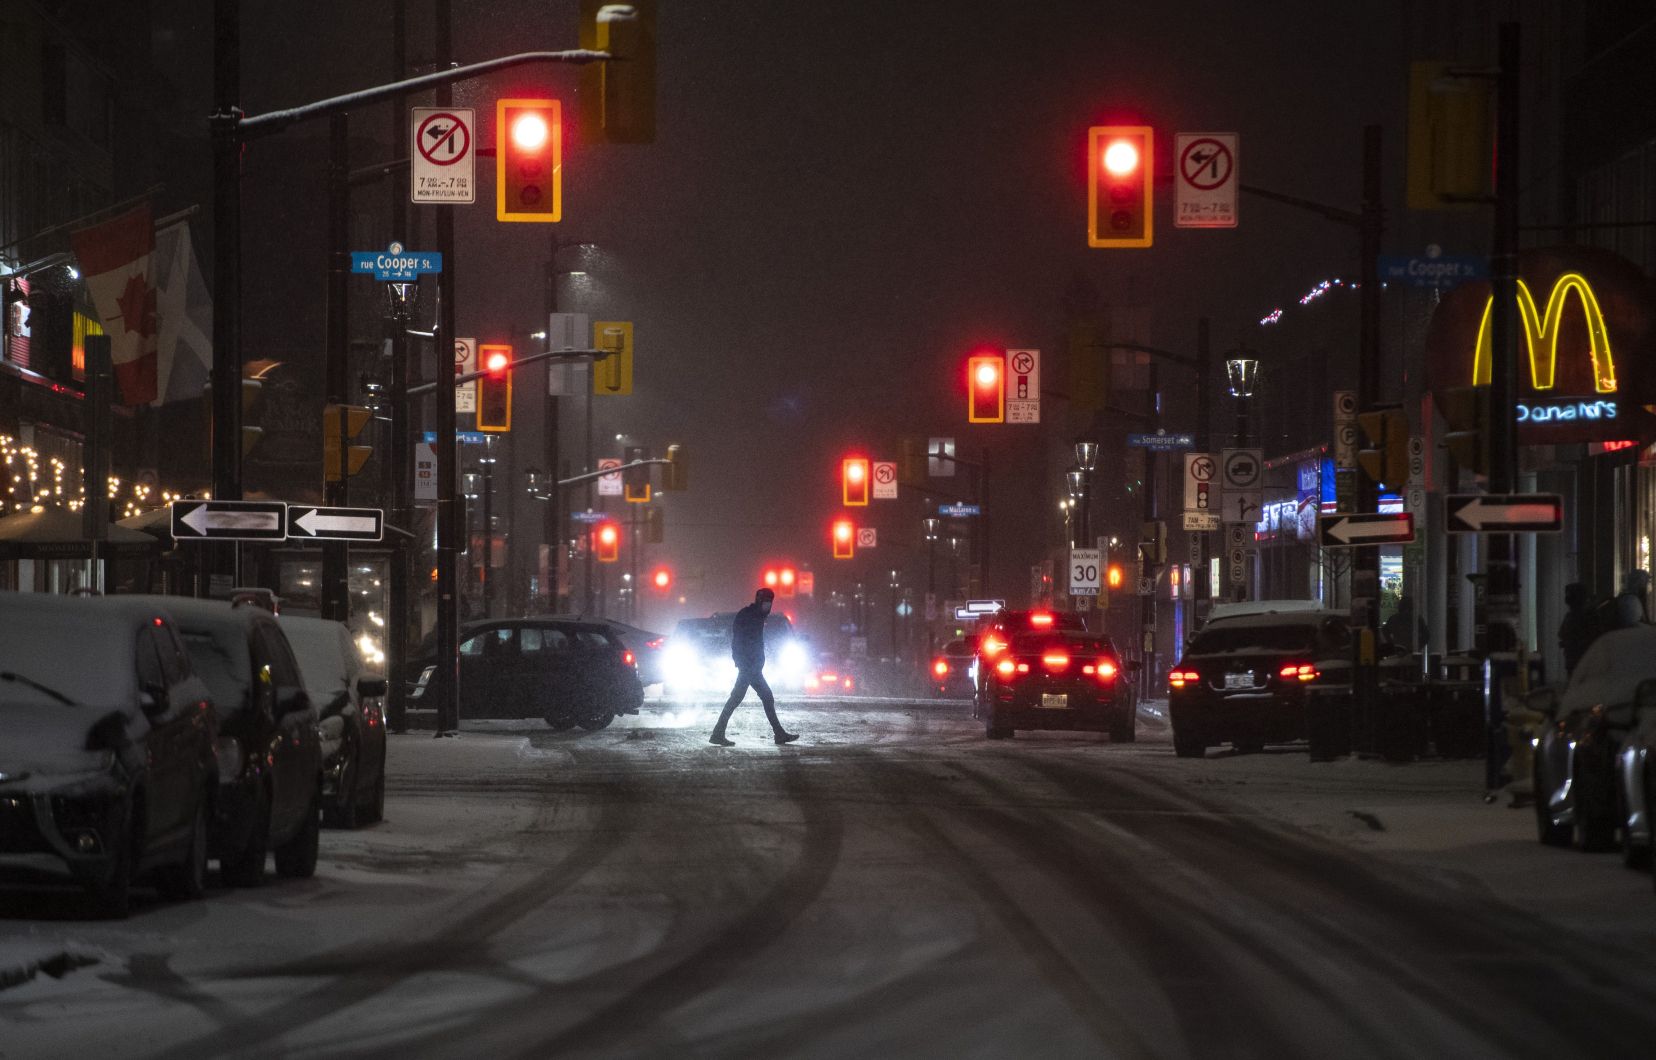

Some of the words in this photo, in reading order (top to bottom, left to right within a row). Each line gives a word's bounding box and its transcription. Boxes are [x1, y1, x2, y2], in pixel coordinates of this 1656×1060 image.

[360, 261, 374, 269] rue
[377, 255, 419, 272] Cooper
[422, 259, 432, 269] St.
[1408, 258, 1459, 277] Cooper
[1142, 435, 1175, 445] Somerset
[1072, 552, 1098, 560] MAXIMUM
[1074, 565, 1097, 582] 30
